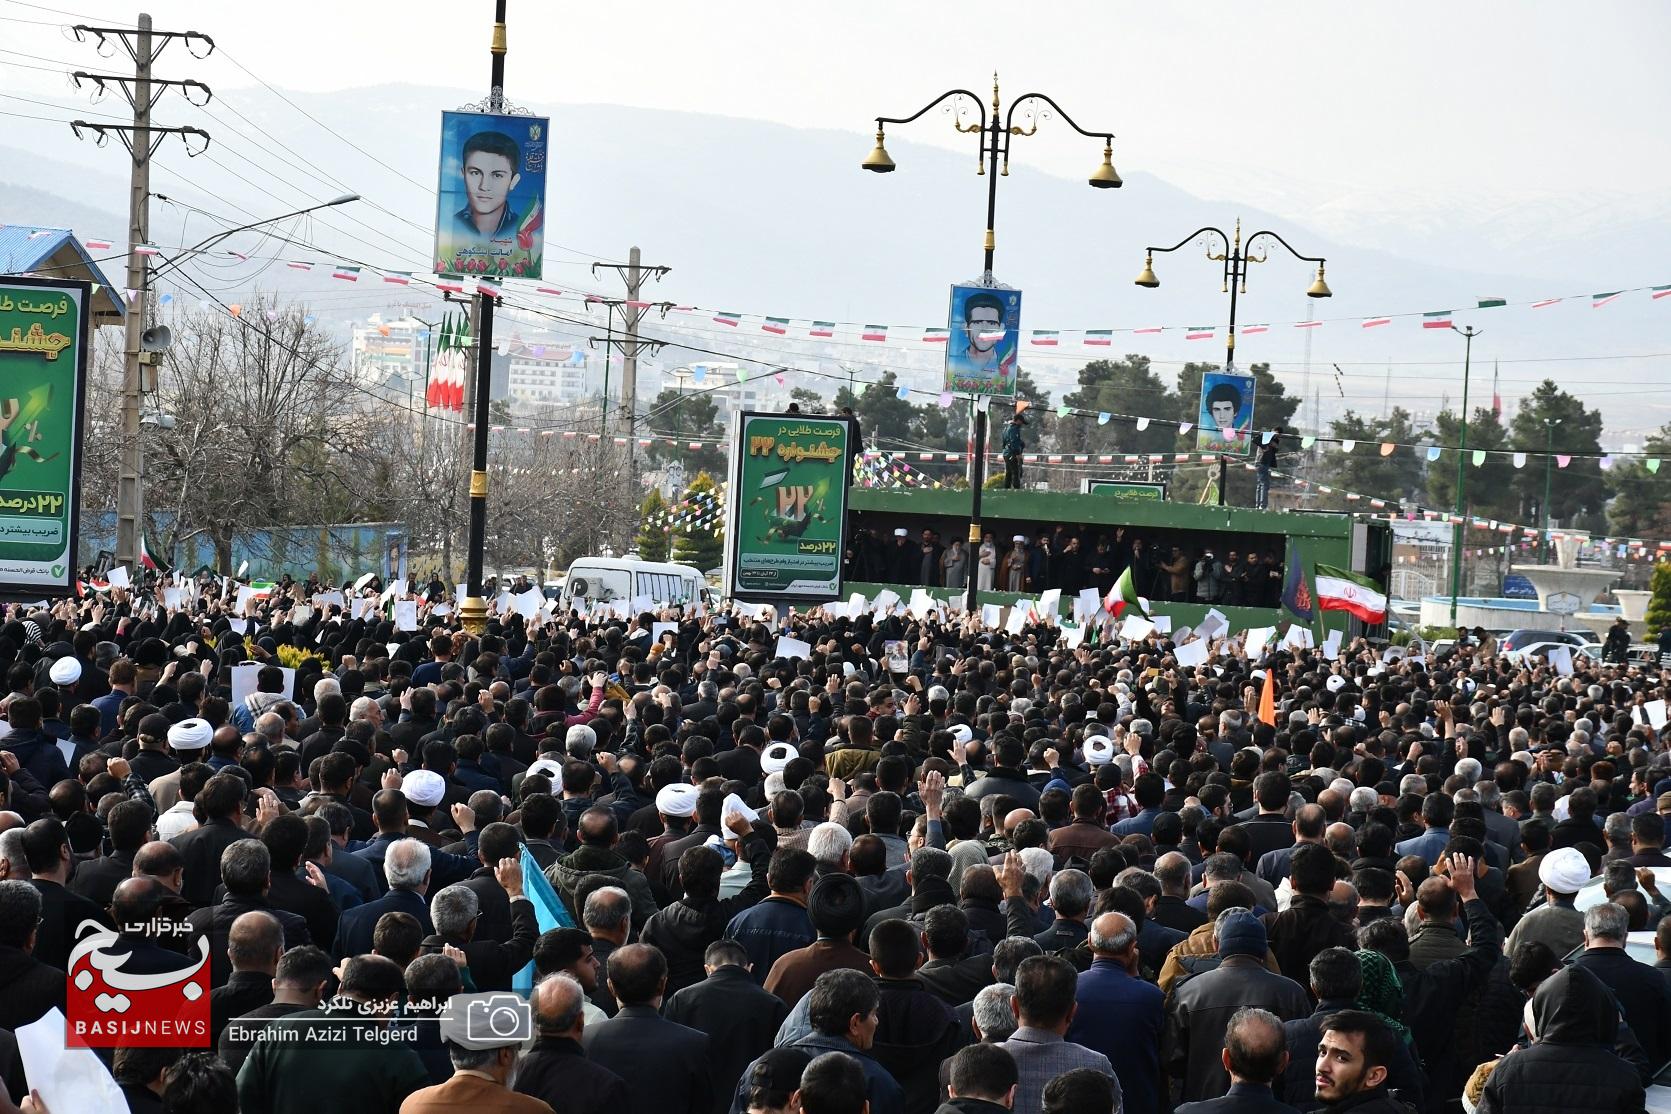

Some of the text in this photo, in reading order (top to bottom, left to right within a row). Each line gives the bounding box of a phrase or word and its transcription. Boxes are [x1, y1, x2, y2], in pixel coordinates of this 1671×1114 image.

[18, 295, 68, 319] فرصت
[777, 425, 841, 439] فرصت طلایی در
[777, 441, 842, 463] جشنواره
[5, 524, 31, 537] بیشتر
[32, 527, 59, 537] ضریب
